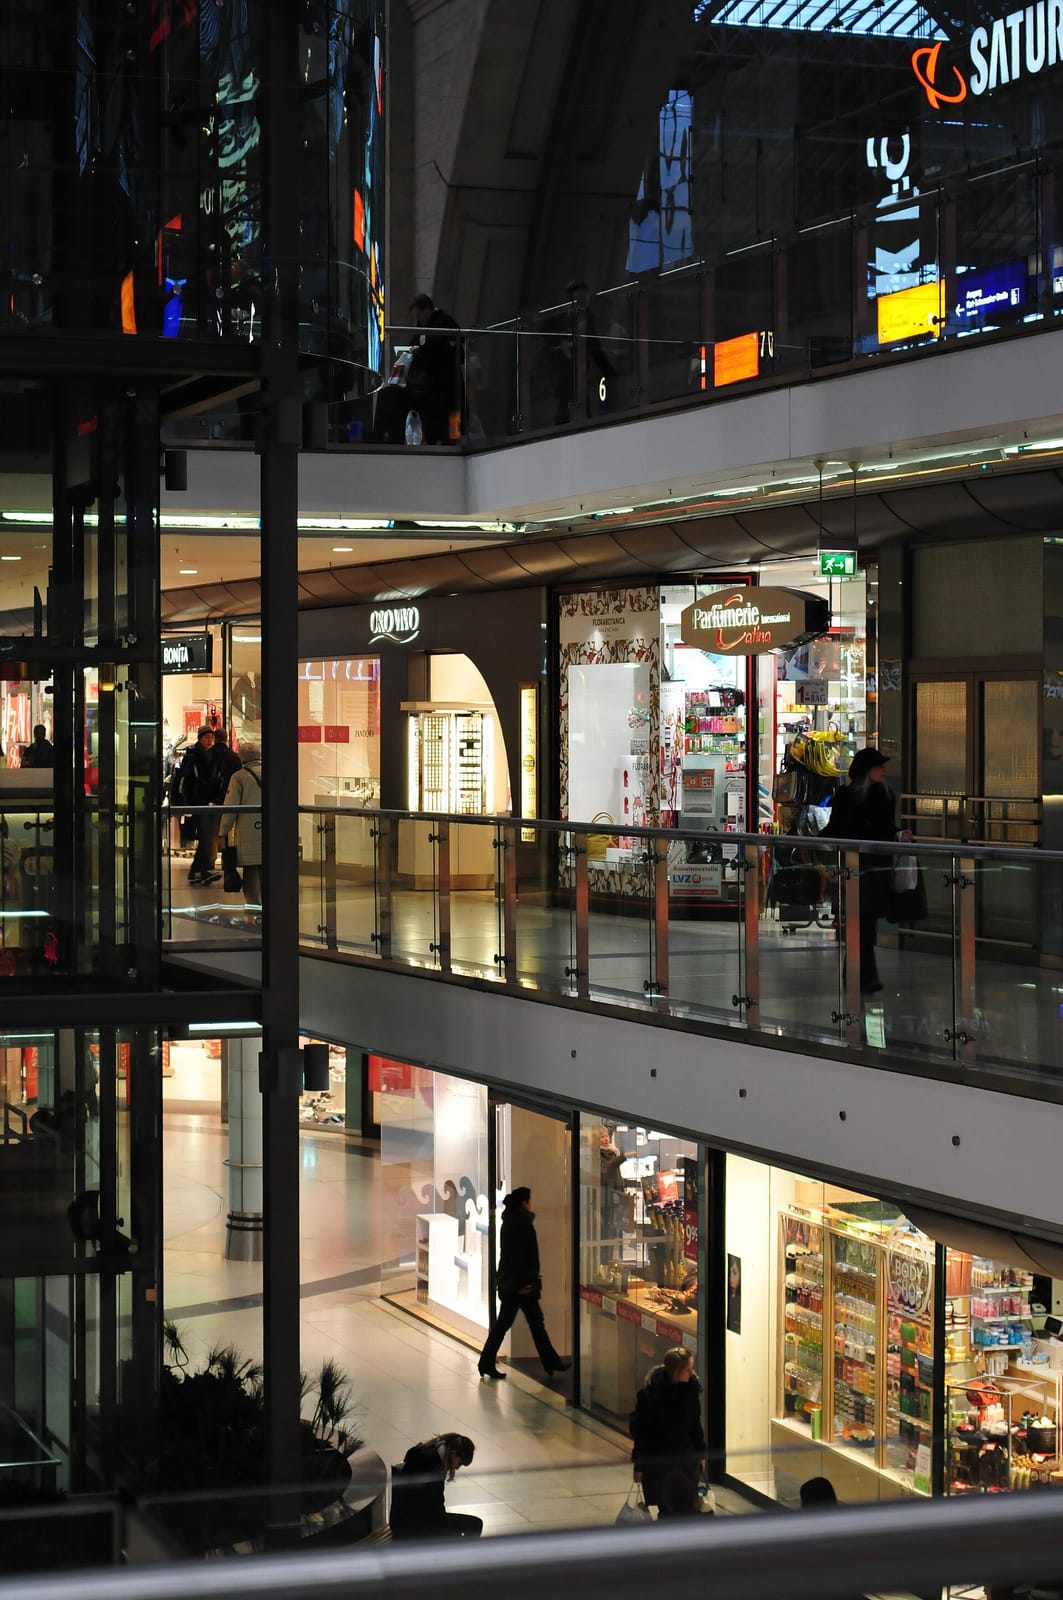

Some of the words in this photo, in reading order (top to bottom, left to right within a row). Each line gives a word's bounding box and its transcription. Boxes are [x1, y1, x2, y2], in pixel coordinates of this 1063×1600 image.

[600, 377, 606, 402] 6
[694, 603, 760, 629] Parfümerie
[163, 644, 189, 667] BONITA
[673, 875, 691, 883] LVZ
[895, 1259, 923, 1283] BODY
